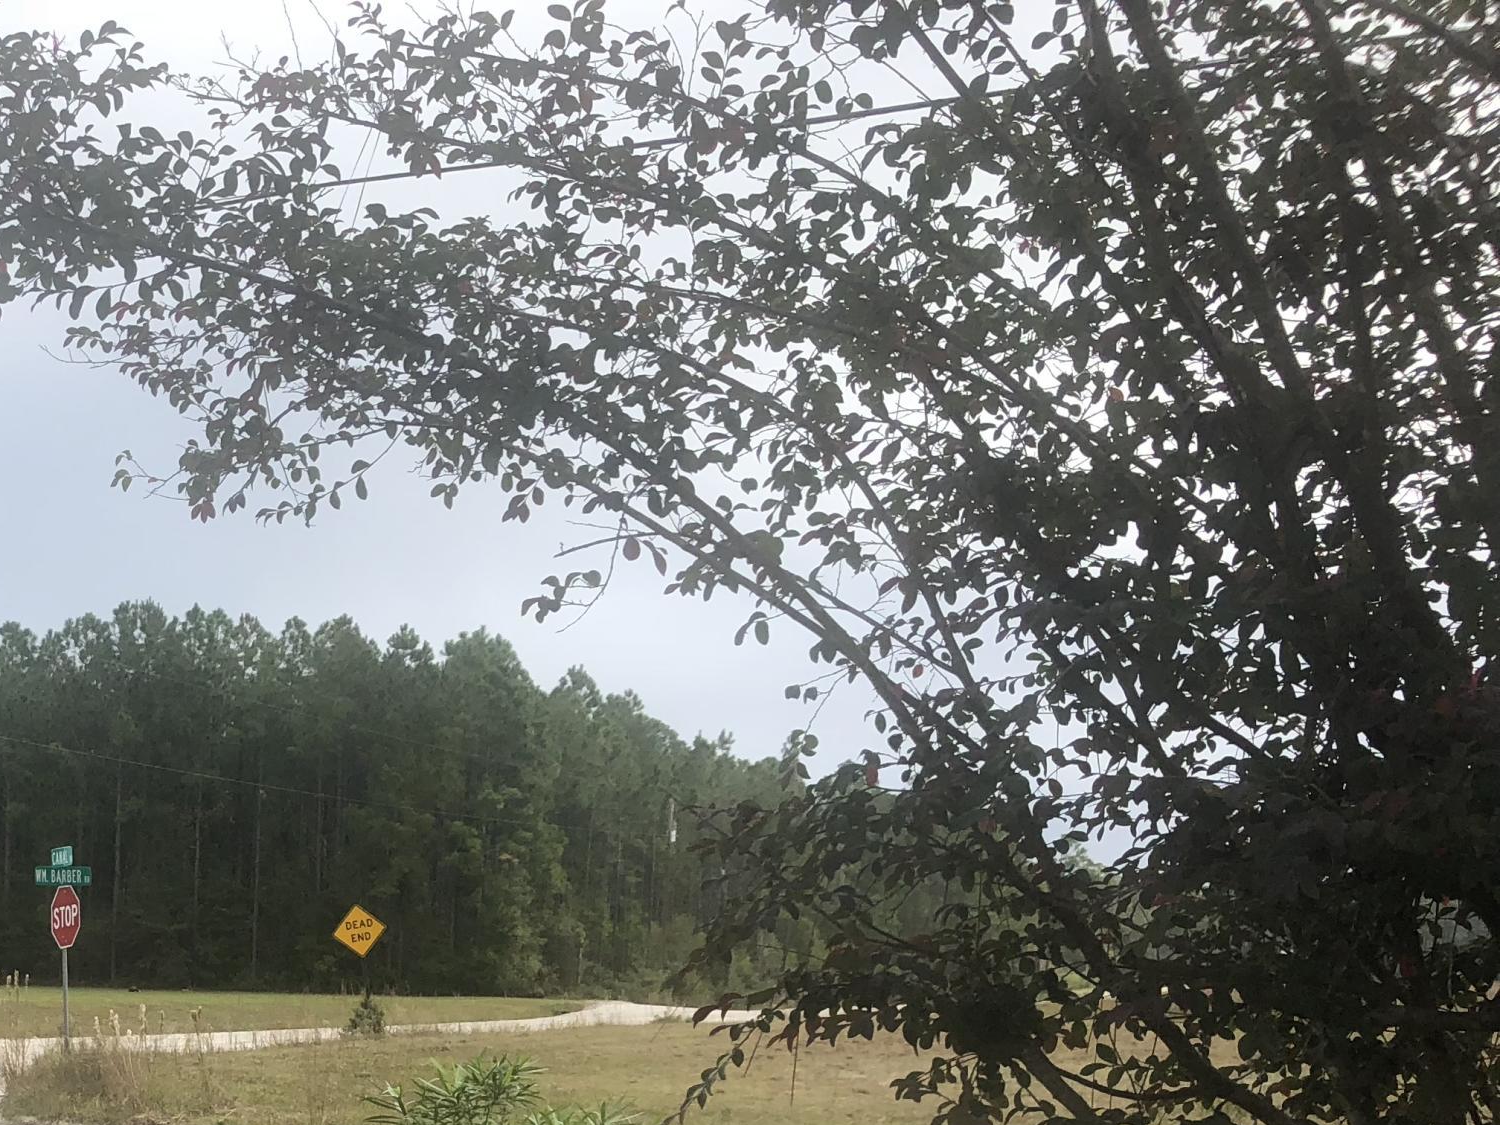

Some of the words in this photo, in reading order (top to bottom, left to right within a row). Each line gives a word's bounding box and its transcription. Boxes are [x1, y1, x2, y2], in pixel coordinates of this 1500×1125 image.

[51, 869, 81, 883] BARBER
[53, 904, 78, 930] STOP
[345, 918, 373, 930] DEAD
[351, 932, 371, 943] END
